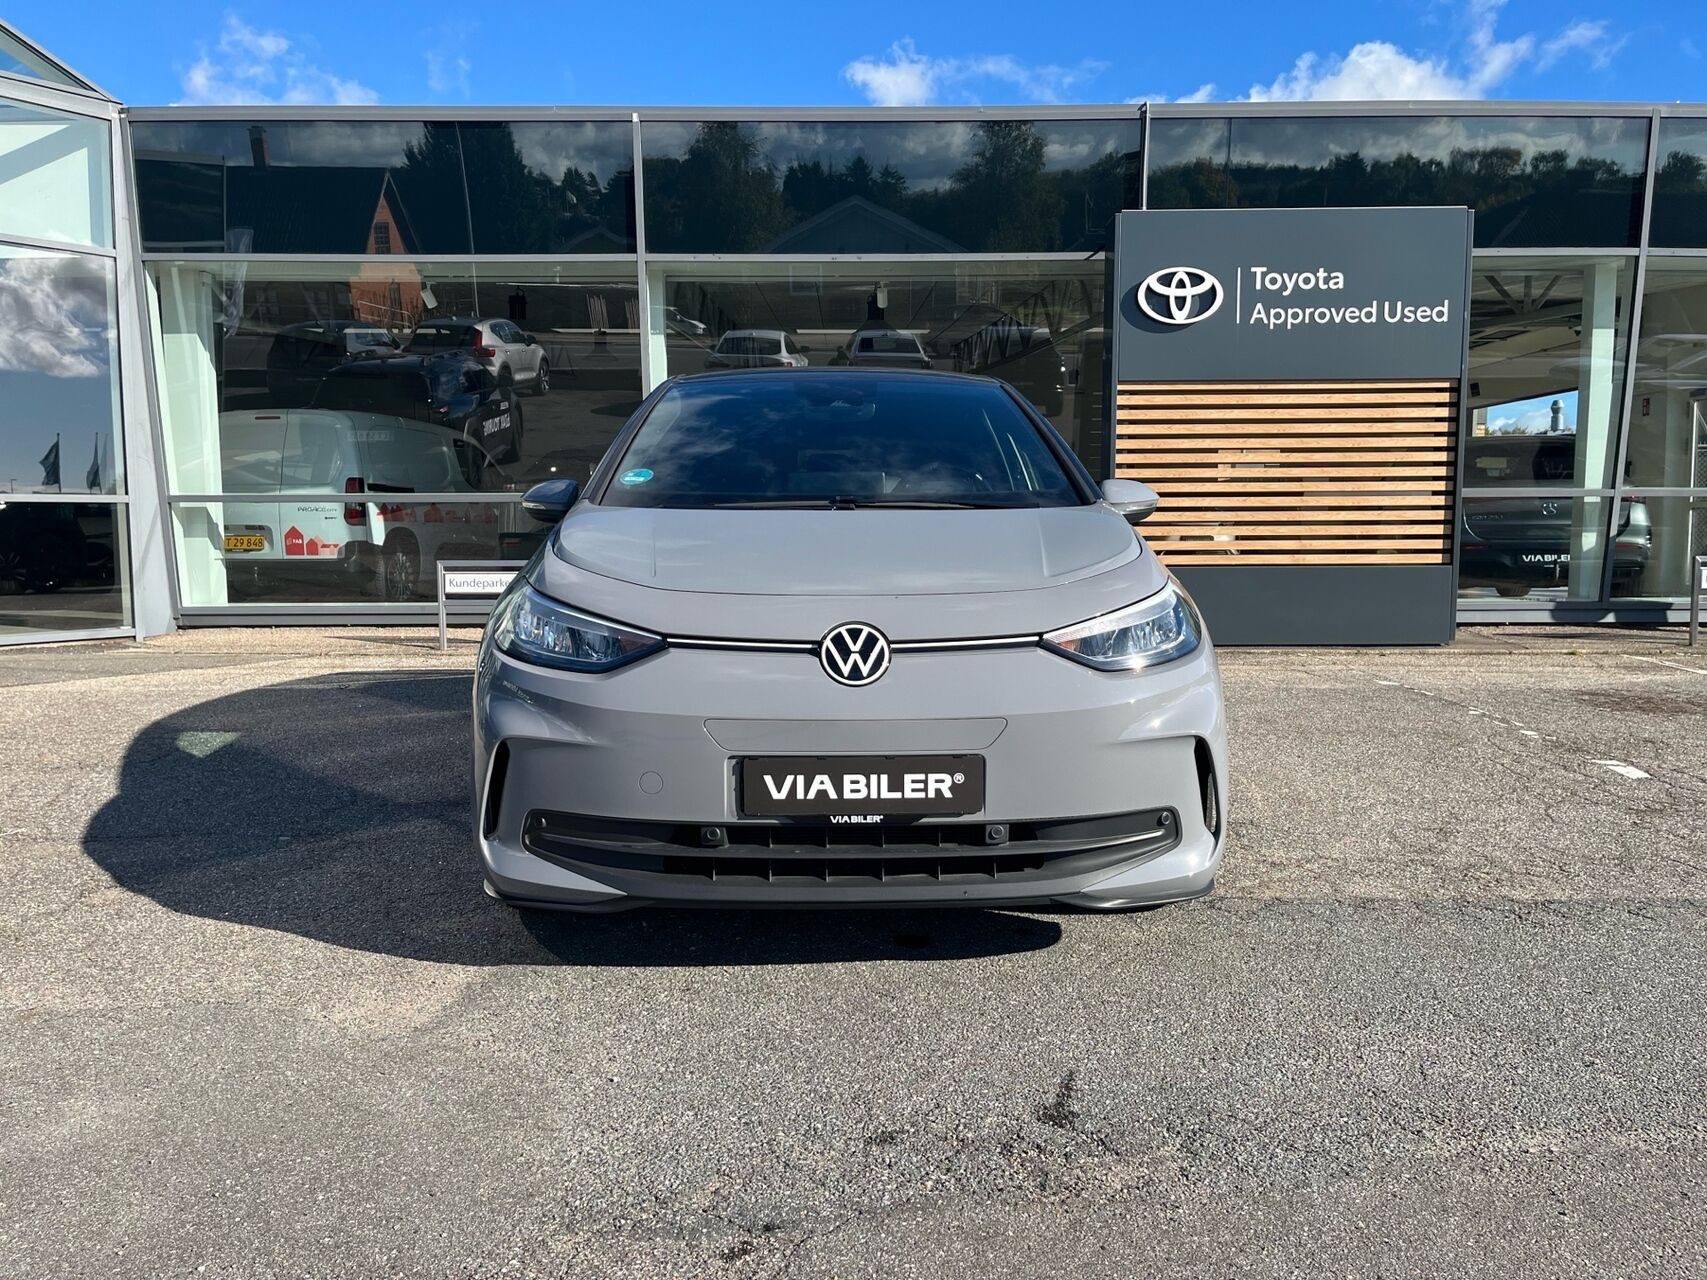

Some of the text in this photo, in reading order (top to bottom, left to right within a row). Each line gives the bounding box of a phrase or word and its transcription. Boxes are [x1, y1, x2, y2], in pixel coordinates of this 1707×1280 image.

[1250, 266, 1344, 296] Toyota
[1250, 299, 1449, 330] Approved Used
[233, 538, 244, 547] 29
[246, 538, 263, 547] 848
